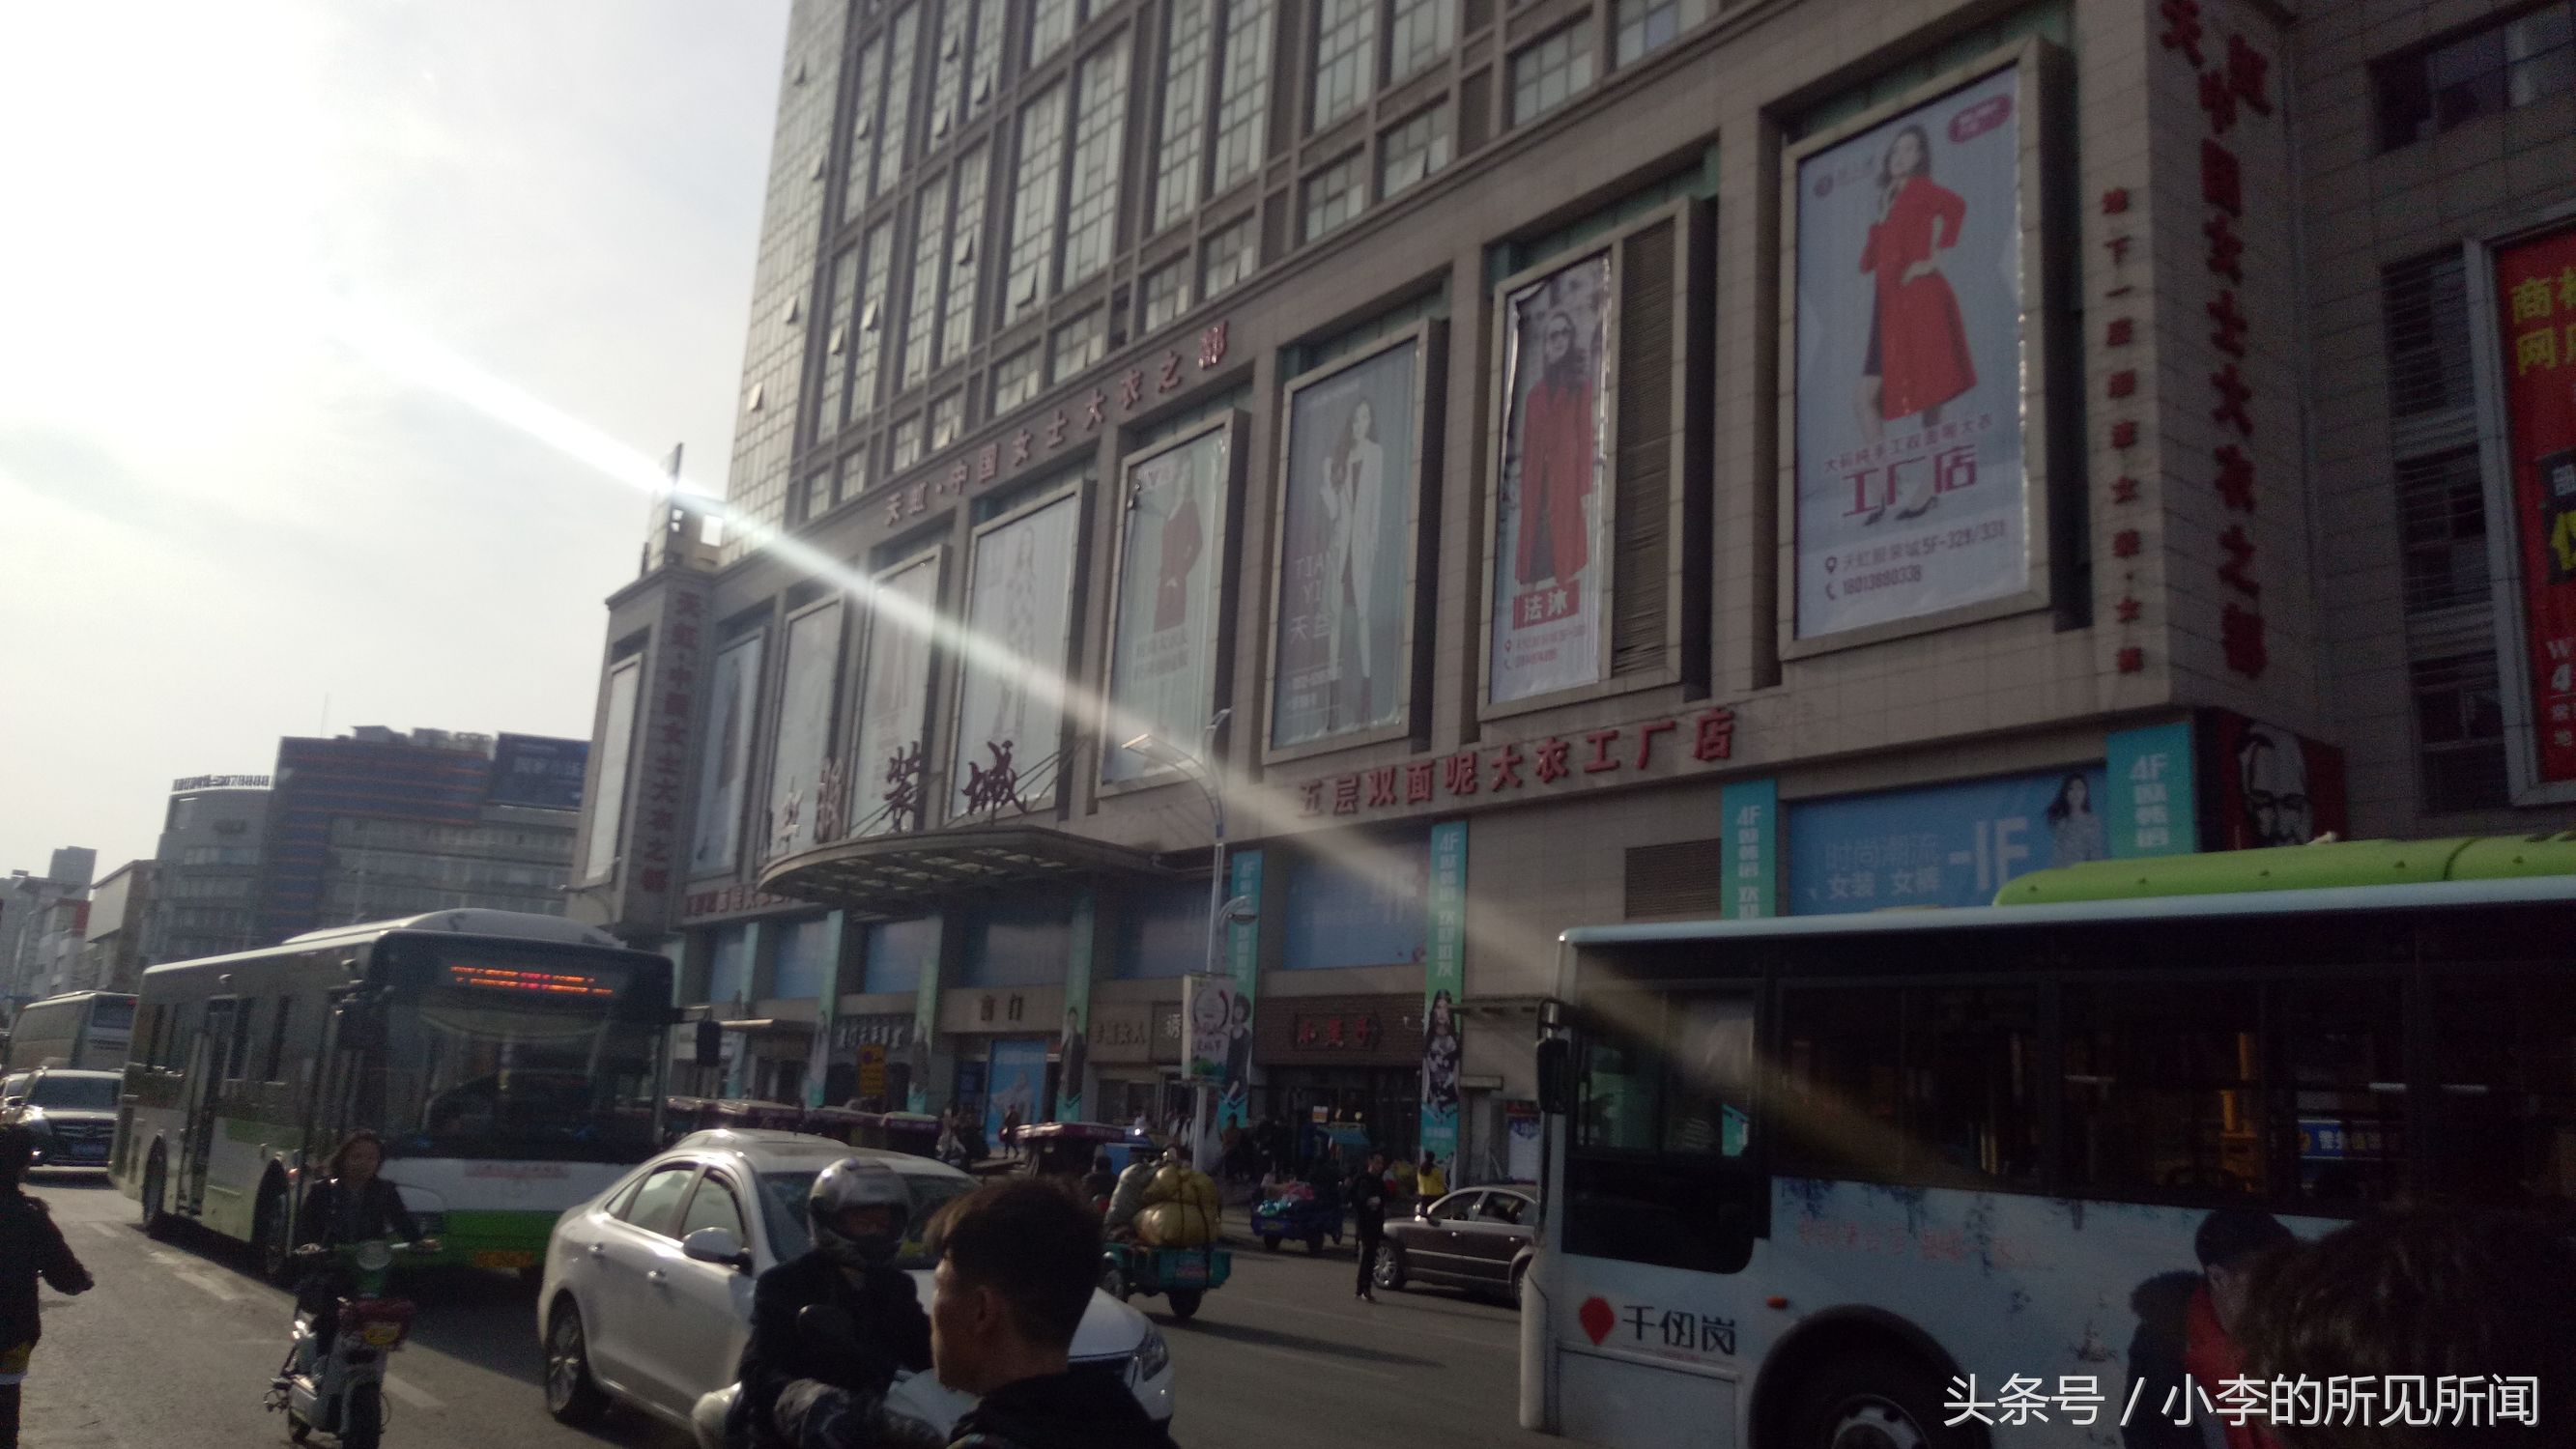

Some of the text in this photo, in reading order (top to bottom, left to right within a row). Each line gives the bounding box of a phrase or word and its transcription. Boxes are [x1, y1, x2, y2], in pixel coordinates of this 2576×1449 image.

[2516, 323, 2576, 376] 网
[1842, 443, 1978, 518] 工厂店
[1298, 707, 1736, 817] 五层双面呢大衣工厂店
